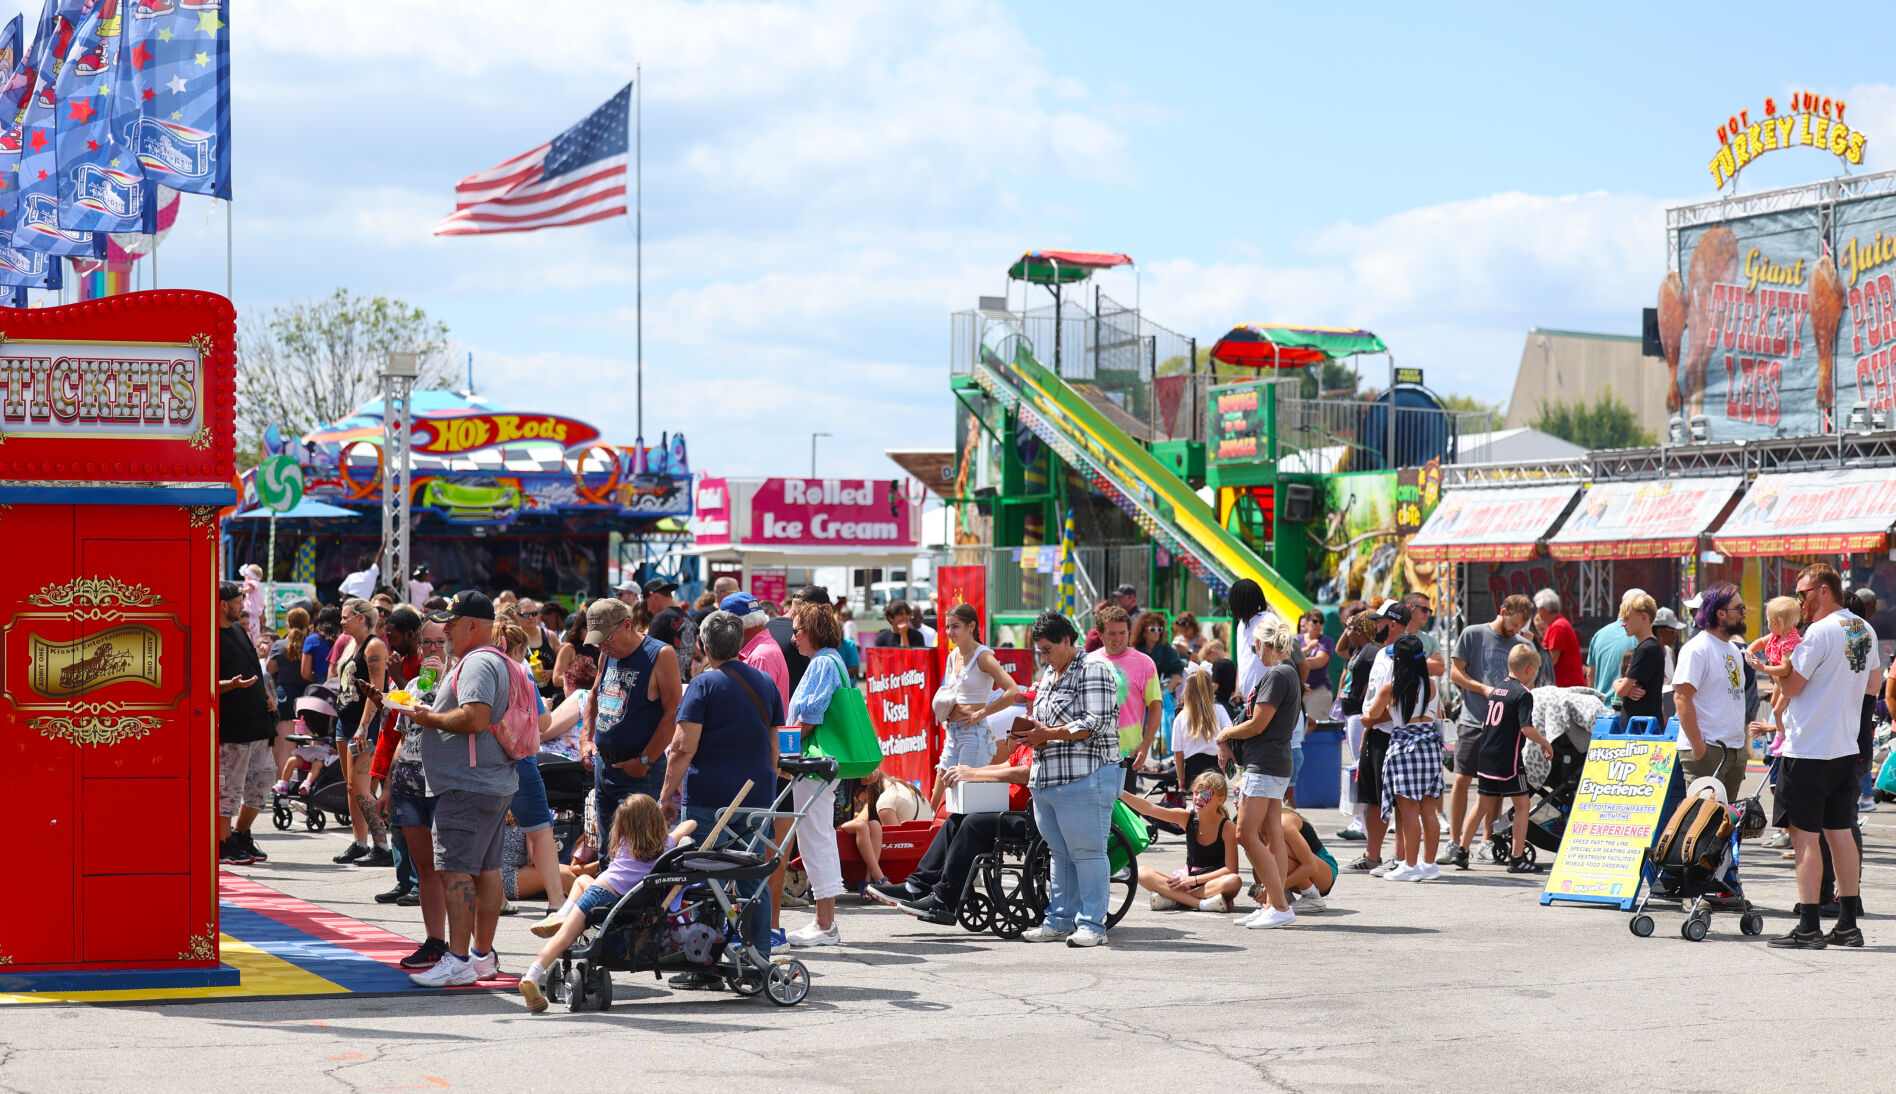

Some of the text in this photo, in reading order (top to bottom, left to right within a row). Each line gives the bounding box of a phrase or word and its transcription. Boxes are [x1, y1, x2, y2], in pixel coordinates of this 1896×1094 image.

[1716, 90, 1846, 145] HOT & JUICY
[1708, 113, 1866, 190] TURKEY LEGS
[1745, 247, 1806, 293] Giant
[1841, 231, 1896, 287] Juic
[1707, 282, 1809, 358] TURKEY
[1848, 273, 1896, 354] POR
[0, 357, 195, 423] TICKETS
[1724, 355, 1783, 426] LEGS
[1857, 345, 1896, 412] CH
[491, 415, 568, 443] Rods
[783, 478, 874, 506] Rolled
[763, 512, 898, 540] Ice Cream
[50, 630, 142, 655] Kissel Entertainment
[867, 669, 926, 693] Thanks for visiting
[883, 694, 910, 723] Kissel
[1485, 700, 1504, 727] 10
[878, 728, 928, 757] tertainment
[1608, 761, 1636, 781] VIP
[1579, 778, 1654, 802] Experience
[1578, 803, 1591, 811] GET
[1603, 804, 1616, 812] THE
[1631, 805, 1656, 813] FASTER
[1572, 823, 1651, 837] VIP EXPERIENCE
